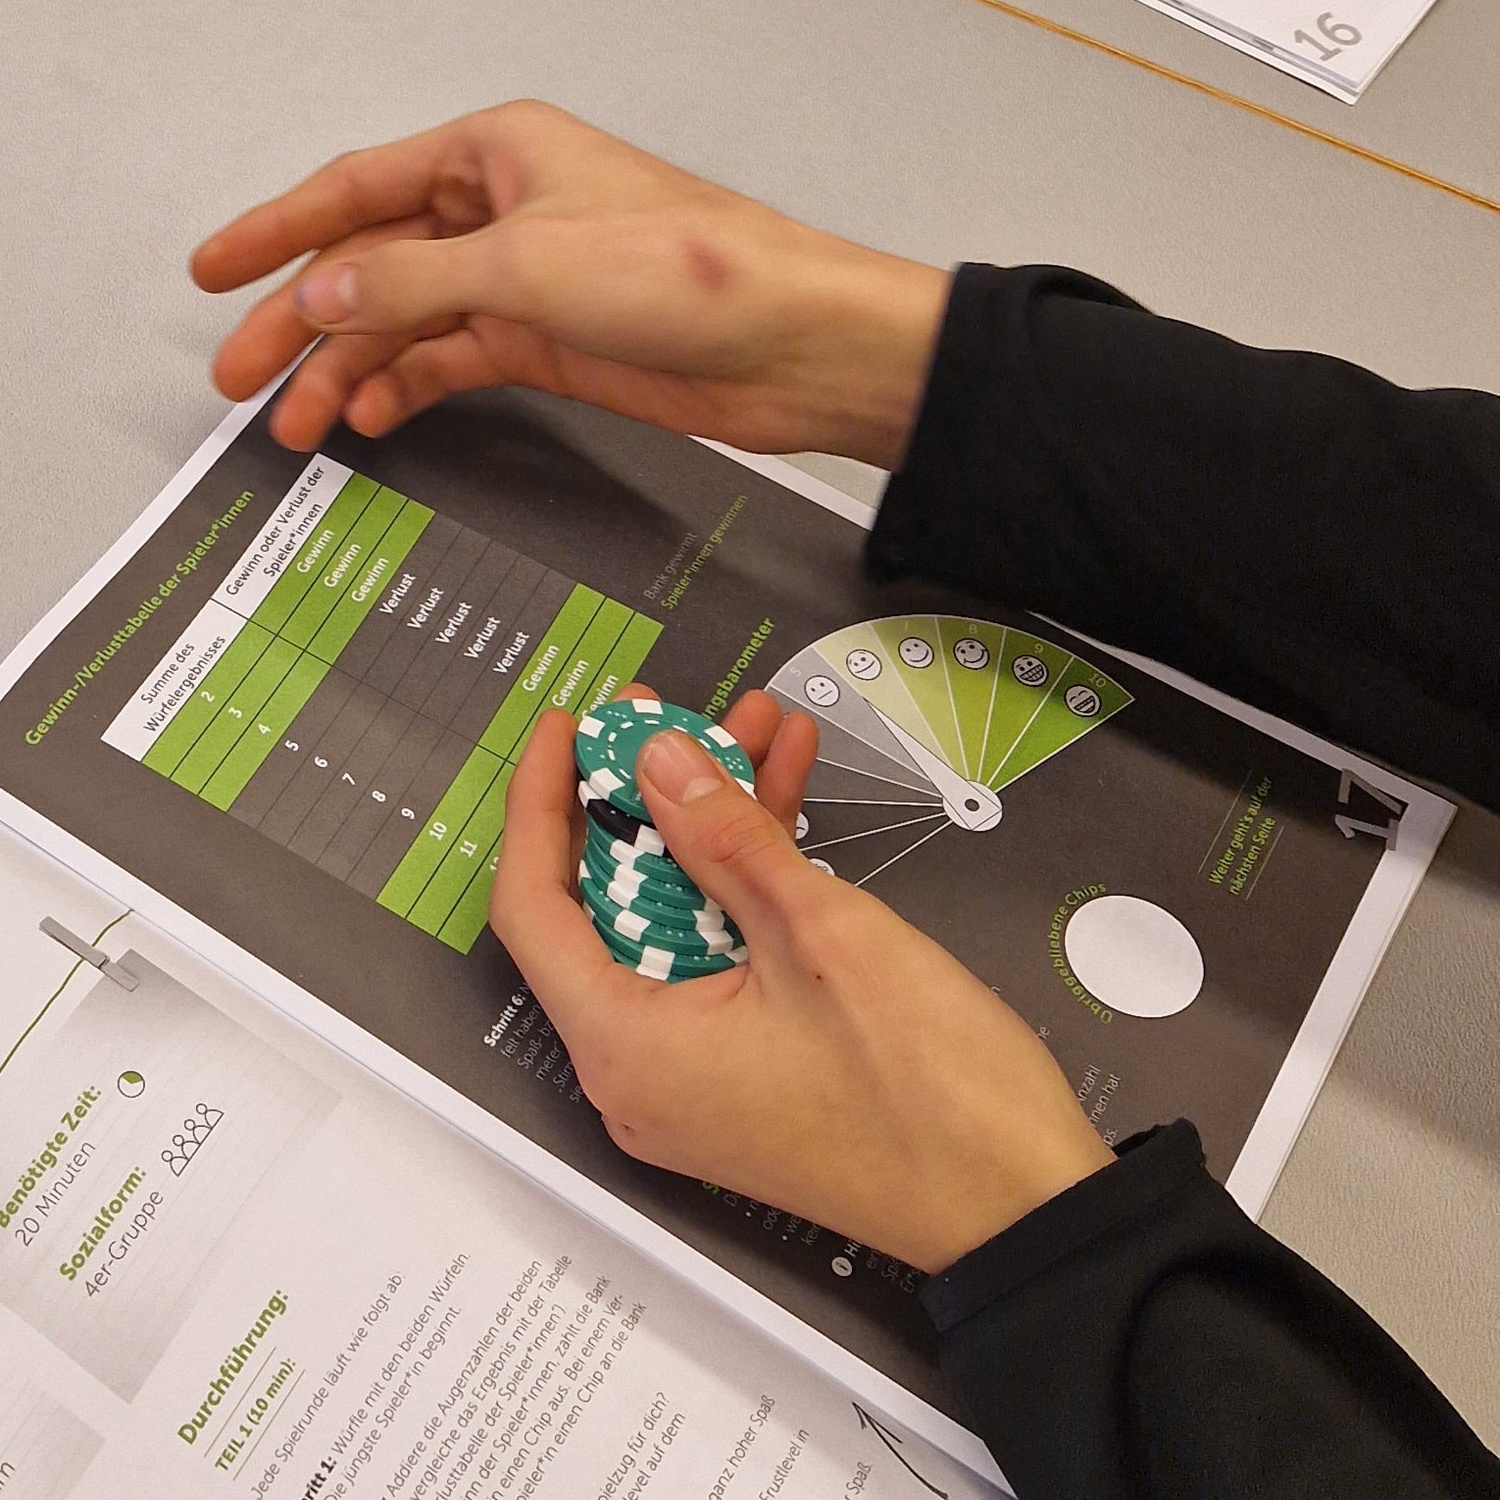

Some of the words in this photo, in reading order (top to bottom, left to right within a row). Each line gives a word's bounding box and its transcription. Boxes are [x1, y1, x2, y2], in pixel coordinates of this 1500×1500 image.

[1294, 11, 1363, 62] 16
[225, 553, 262, 597] Gewinn
[260, 523, 282, 557] oder
[275, 484, 310, 525] Verlust
[305, 465, 326, 492] der
[643, 573, 670, 601] Bank
[664, 531, 699, 576] gewinnt
[710, 494, 749, 546] gewinnen
[24, 592, 163, 748] Gewinn-/Verlusttabelle
[158, 570, 182, 599] der
[140, 660, 177, 706] Summe
[173, 641, 195, 667] des
[201, 691, 215, 702] 2
[296, 527, 335, 575] Gewinn
[229, 707, 243, 719] 3
[323, 542, 362, 589] Gewinn
[257, 723, 272, 735] 4
[350, 556, 389, 603] Gewinn
[284, 739, 299, 752] 5
[379, 572, 417, 616] Verlust
[314, 756, 329, 768] 6
[407, 587, 444, 631] Verlust
[702, 616, 775, 721] ngsbarometer
[143, 635, 226, 735] Würfelergebnisses
[342, 772, 357, 786] 7
[434, 601, 473, 645] Verlust
[371, 790, 387, 803] 8
[463, 616, 501, 660] Verlust
[401, 807, 416, 820] 9
[492, 631, 530, 675] Verlust
[428, 821, 448, 841] 10
[522, 643, 560, 693] Gewinn
[459, 840, 478, 858] 11
[551, 659, 589, 708] Gewinn
[1335, 768, 1409, 851] 17
[1064, 882, 1107, 907] Chips
[484, 1003, 519, 1048] Schritt
[511, 991, 527, 1006] 6:
[60, 1085, 102, 1132] Zeit:
[14, 1216, 41, 1248] 20
[35, 1139, 96, 1219] Minuten
[59, 1165, 148, 1282] Sozialform:
[85, 1189, 165, 1298] 4er-Gruppe
[177, 1288, 289, 1446] Durchführung:
[274, 1386, 330, 1462] Spielrunde
[325, 1353, 352, 1387] läuft
[347, 1327, 369, 1353] wie
[362, 1293, 391, 1327] folgt
[386, 1440, 428, 1498] Addiere
[423, 1415, 443, 1440] die
[437, 1326, 500, 1417] Augenzahlen
[495, 1301, 514, 1326] der
[508, 1260, 543, 1303] beiden
[456, 1401, 478, 1428] das
[472, 1340, 517, 1403] Ergebnis
[512, 1316, 532, 1342] mit
[527, 1293, 546, 1318] der
[538, 1255, 573, 1294] Tabelle
[554, 1404, 584, 1445] einen
[576, 1369, 605, 1404] Chip
[599, 1350, 617, 1371] an
[620, 1301, 648, 1332] Bank
[555, 1323, 581, 1358] zahlt
[585, 1275, 612, 1305] Bank
[217, 1438, 245, 1472] TEIL
[246, 1398, 269, 1426] (10
[265, 1357, 297, 1399] min):
[320, 1456, 338, 1474] 1:
[331, 1408, 369, 1455] Würfle
[364, 1381, 386, 1408] mit
[381, 1351, 404, 1382] den
[397, 1304, 436, 1353] beiden
[343, 1428, 382, 1486] jüngste
[419, 1306, 463, 1361] beginnt.
[500, 1448, 531, 1490] einen
[523, 1411, 552, 1446] Chip
[563, 1356, 586, 1382] Bei
[581, 1317, 611, 1358] einem
[603, 1294, 624, 1317] Ver-
[627, 1431, 647, 1454] für
[643, 1391, 669, 1431] dich?
[646, 1442, 665, 1472] auf
[661, 1412, 687, 1446] dem
[727, 1425, 758, 1468] hoher
[749, 1394, 776, 1427] Spaß
[795, 1428, 811, 1446] in
